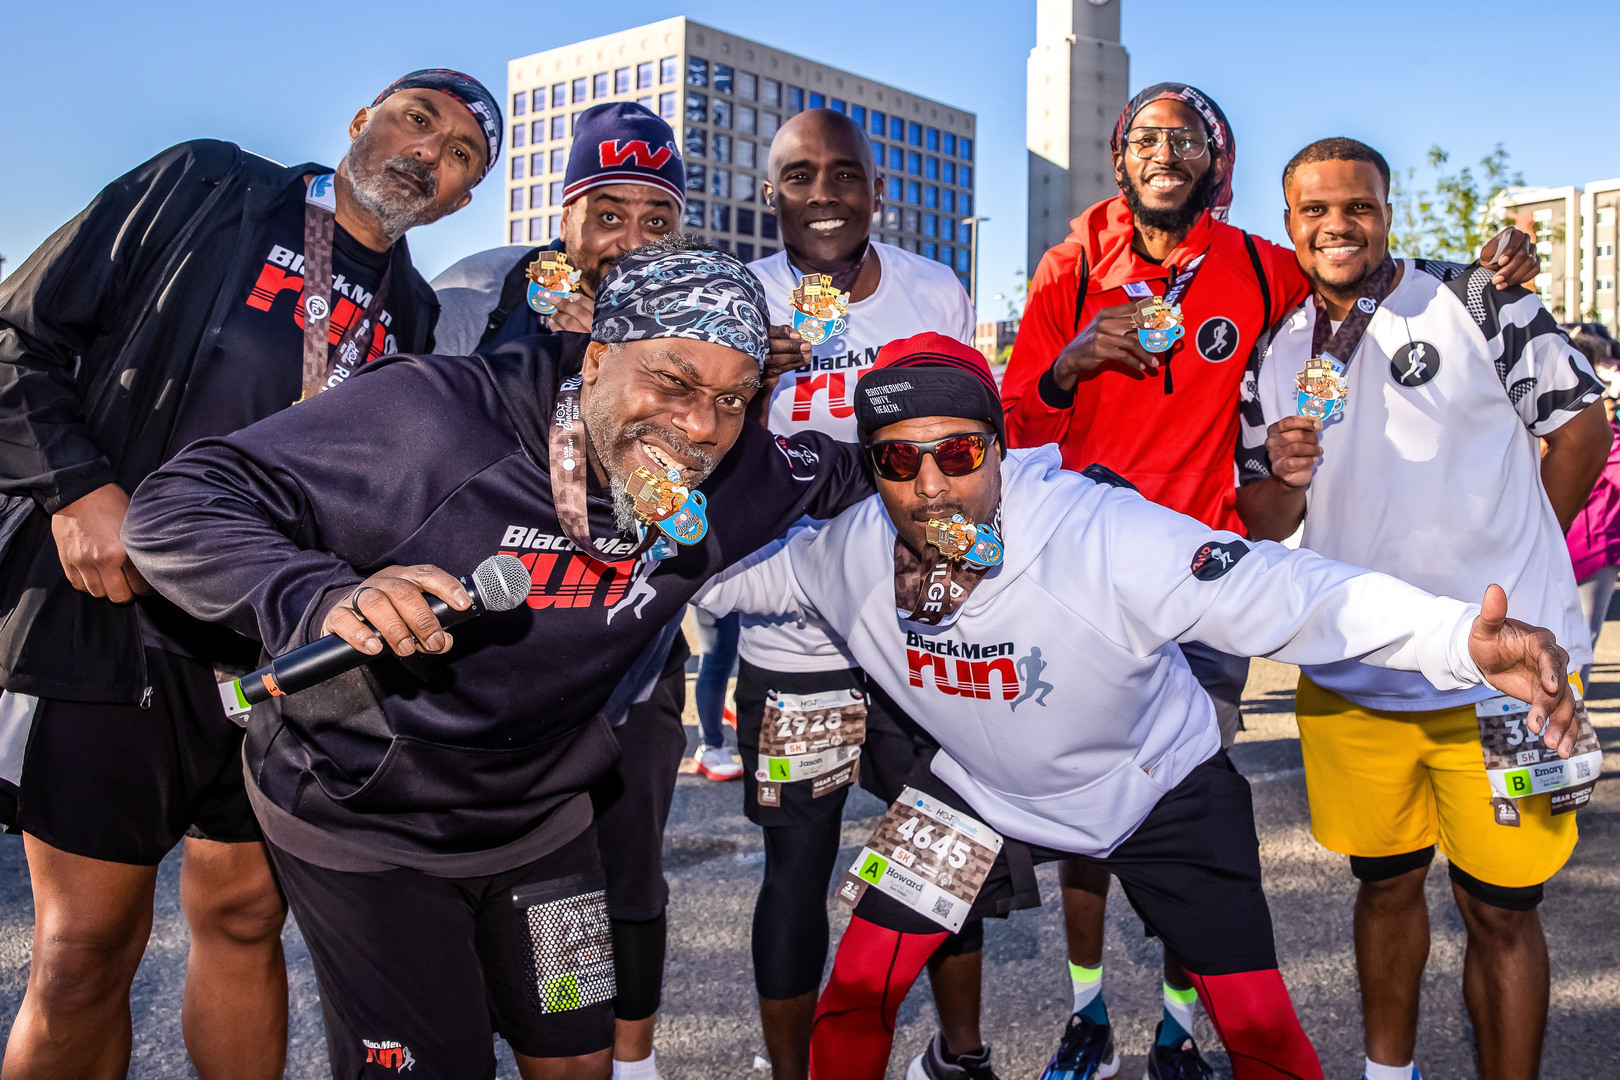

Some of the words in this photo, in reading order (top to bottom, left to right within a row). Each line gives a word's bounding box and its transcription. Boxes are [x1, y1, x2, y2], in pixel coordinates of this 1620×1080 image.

[267, 244, 349, 297] Blk
[350, 284, 393, 327] Mn
[791, 367, 880, 421] ru
[864, 381, 914, 397] BROTHERHOOD.
[869, 395, 891, 406] UNITY.
[873, 403, 902, 414] HEALTH.
[555, 402, 566, 427] HOT
[572, 404, 580, 420] RUN
[673, 507, 692, 527] HOT
[906, 648, 1020, 701] run
[789, 744, 802, 752] 5K
[799, 757, 823, 768] Jason
[1521, 752, 1535, 762] 5K
[1534, 765, 1564, 777] Emory
[1512, 776, 1525, 791] B
[935, 808, 955, 821] HOT
[896, 816, 972, 869] 4645
[896, 850, 912, 863] 5K
[864, 861, 879, 878] A
[885, 866, 925, 893] Howard
